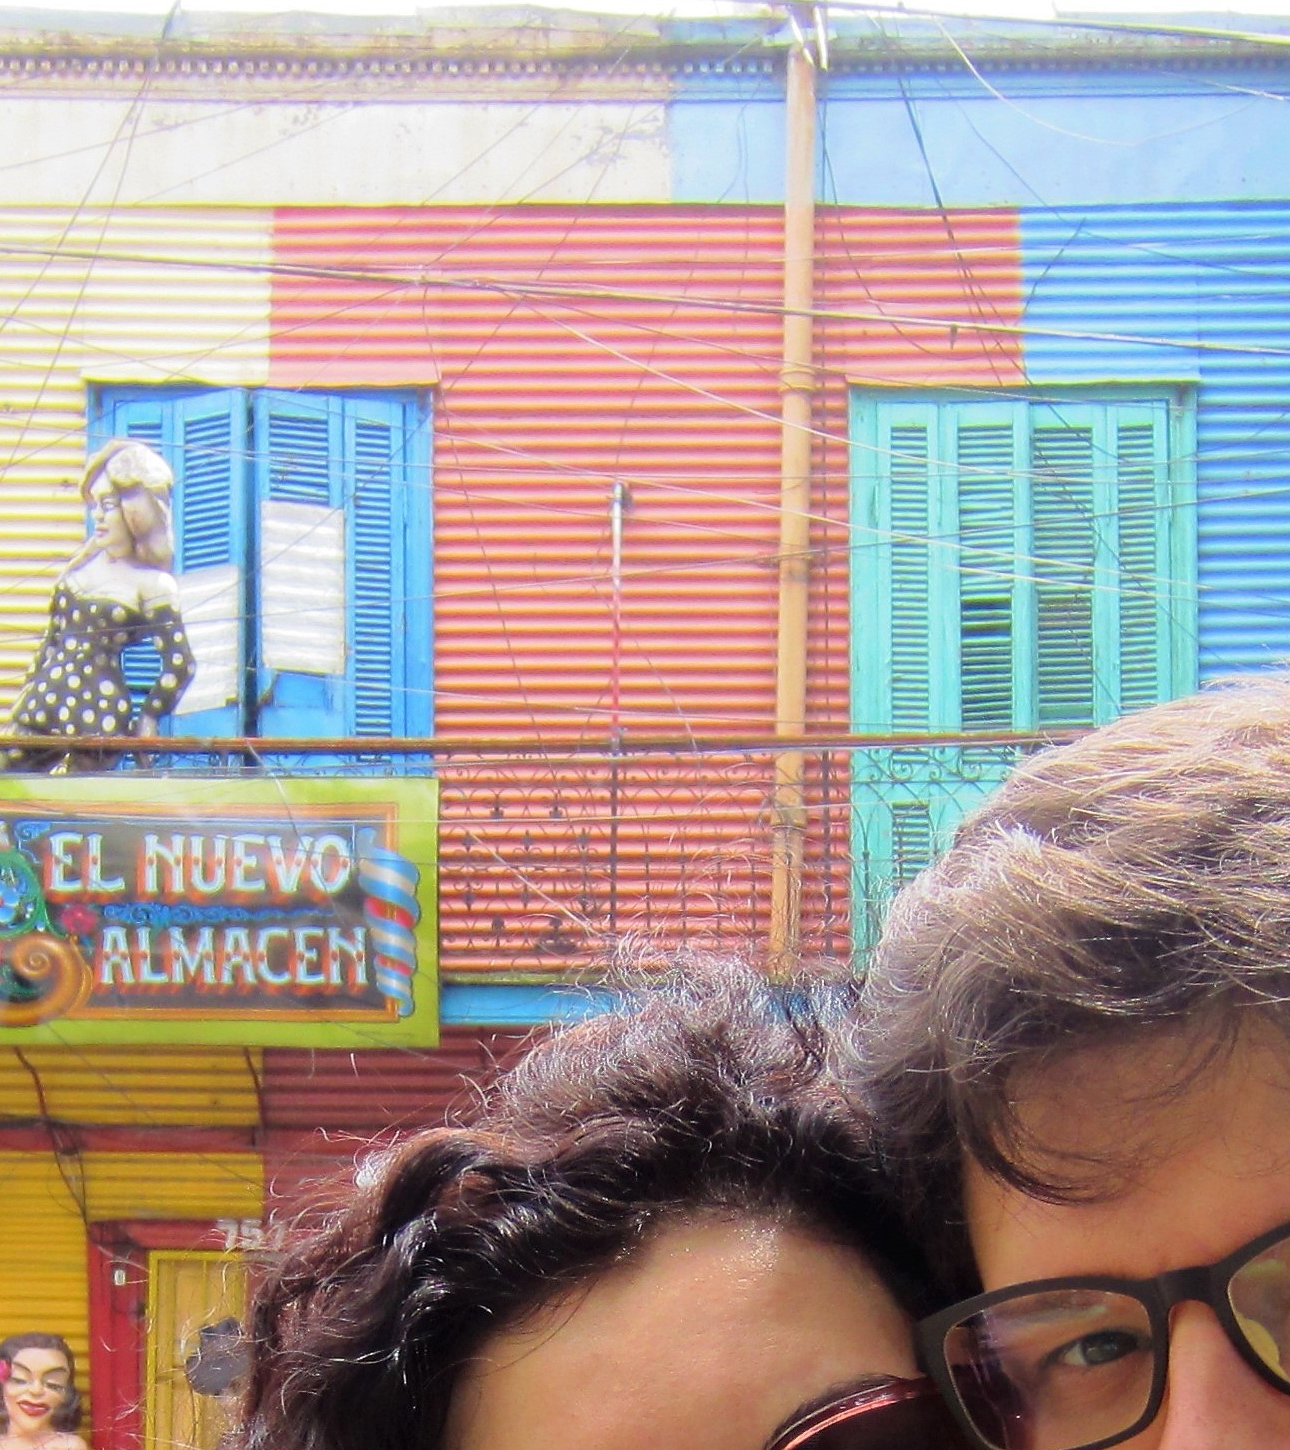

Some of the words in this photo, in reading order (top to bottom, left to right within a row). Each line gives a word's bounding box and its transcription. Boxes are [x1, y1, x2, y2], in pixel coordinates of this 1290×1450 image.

[46, 832, 126, 896] EL
[141, 832, 352, 897] NUEVO
[98, 925, 368, 987] ALMACEN
